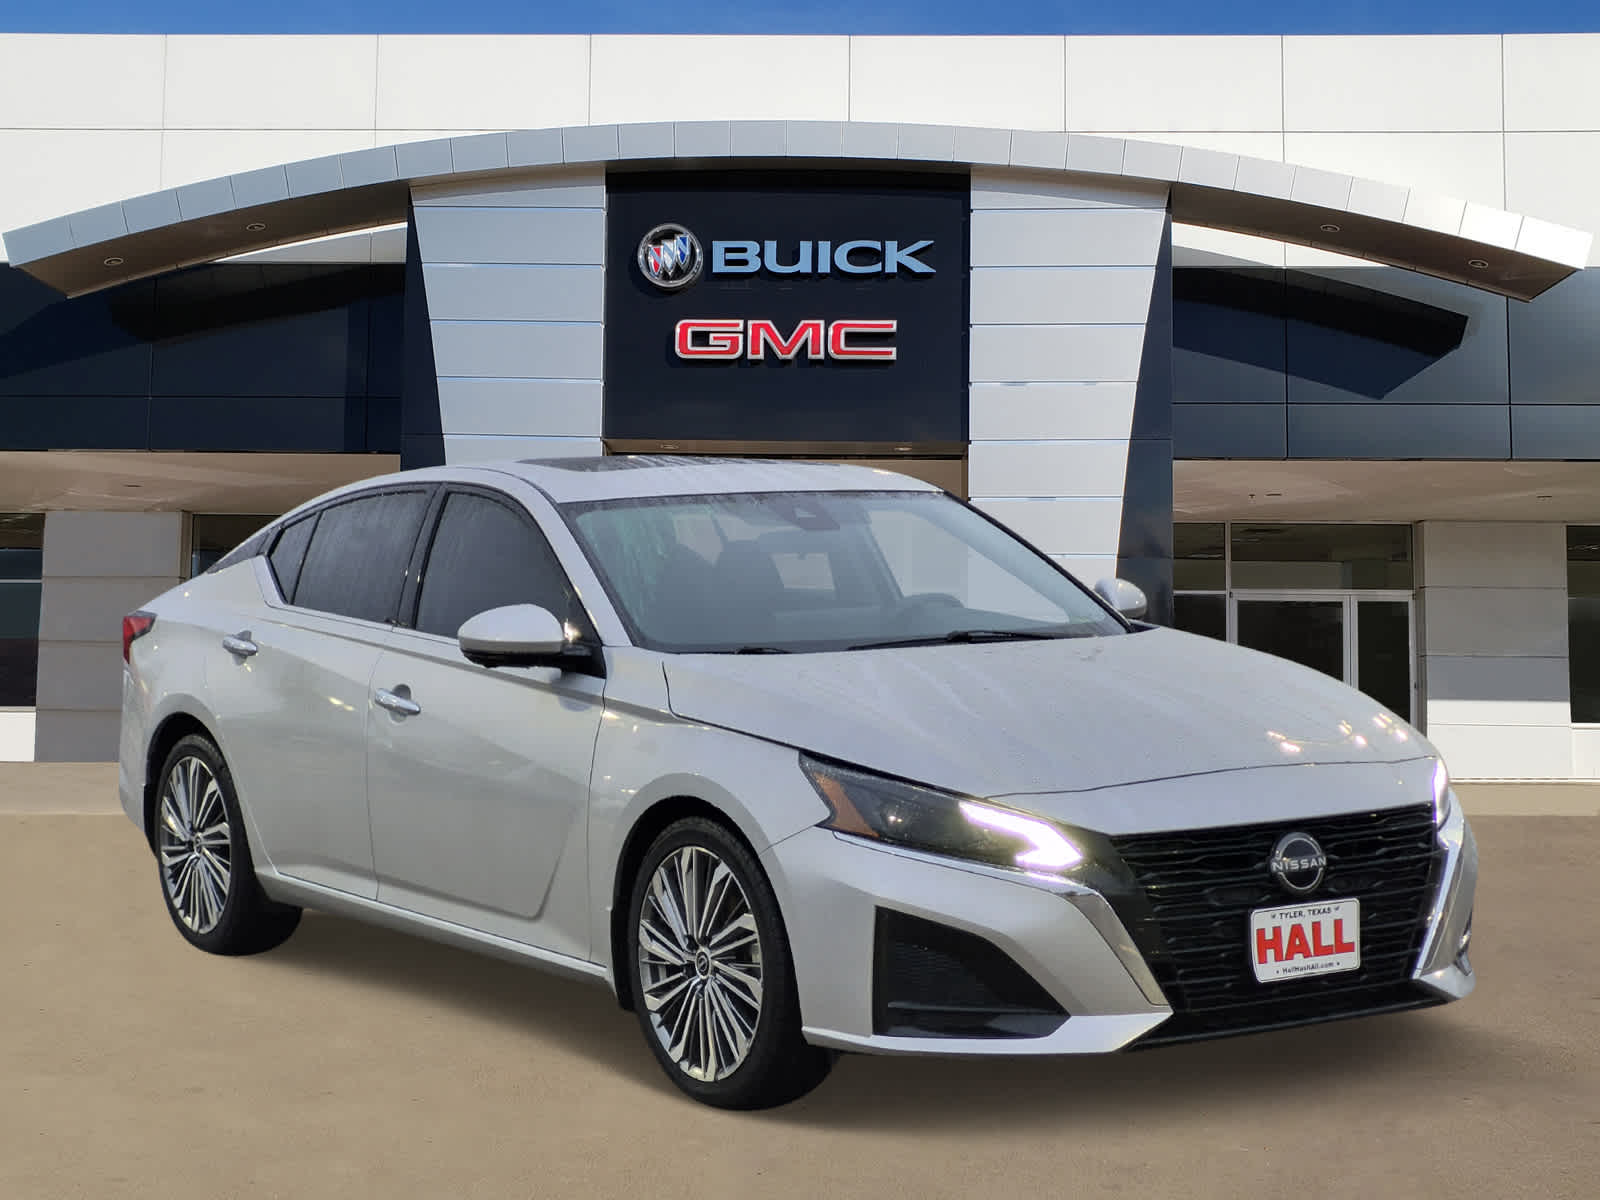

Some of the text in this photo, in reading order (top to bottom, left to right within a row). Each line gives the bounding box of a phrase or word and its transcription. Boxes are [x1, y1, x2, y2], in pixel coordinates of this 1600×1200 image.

[711, 240, 937, 275] BUICK
[674, 319, 898, 361] GMC
[1272, 856, 1327, 871] NISSAN
[1279, 906, 1332, 920] TYLER, TEXAS
[1256, 918, 1355, 965] HALL
